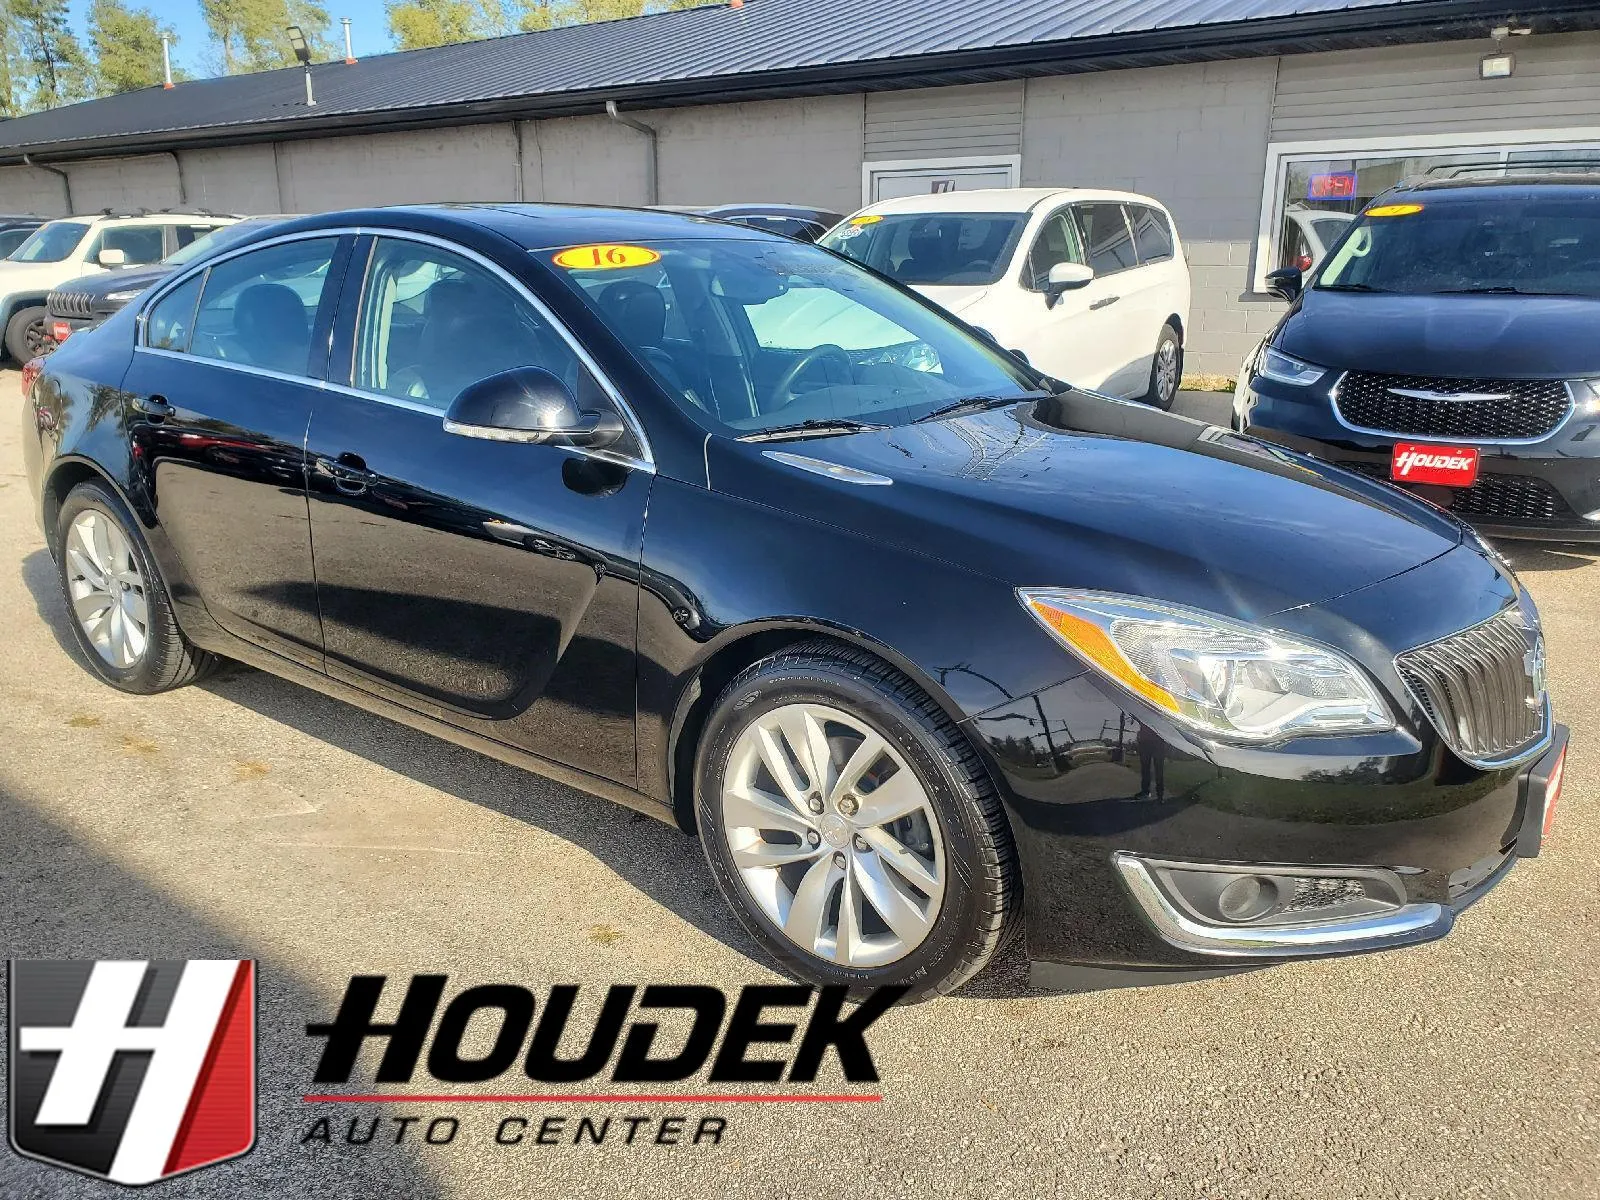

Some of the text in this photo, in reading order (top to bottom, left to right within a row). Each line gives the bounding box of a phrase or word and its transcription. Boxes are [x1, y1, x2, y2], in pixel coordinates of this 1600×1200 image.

[1311, 175, 1354, 198] OPEN
[592, 248, 626, 266] 16
[1395, 451, 1474, 476] HOUDEK
